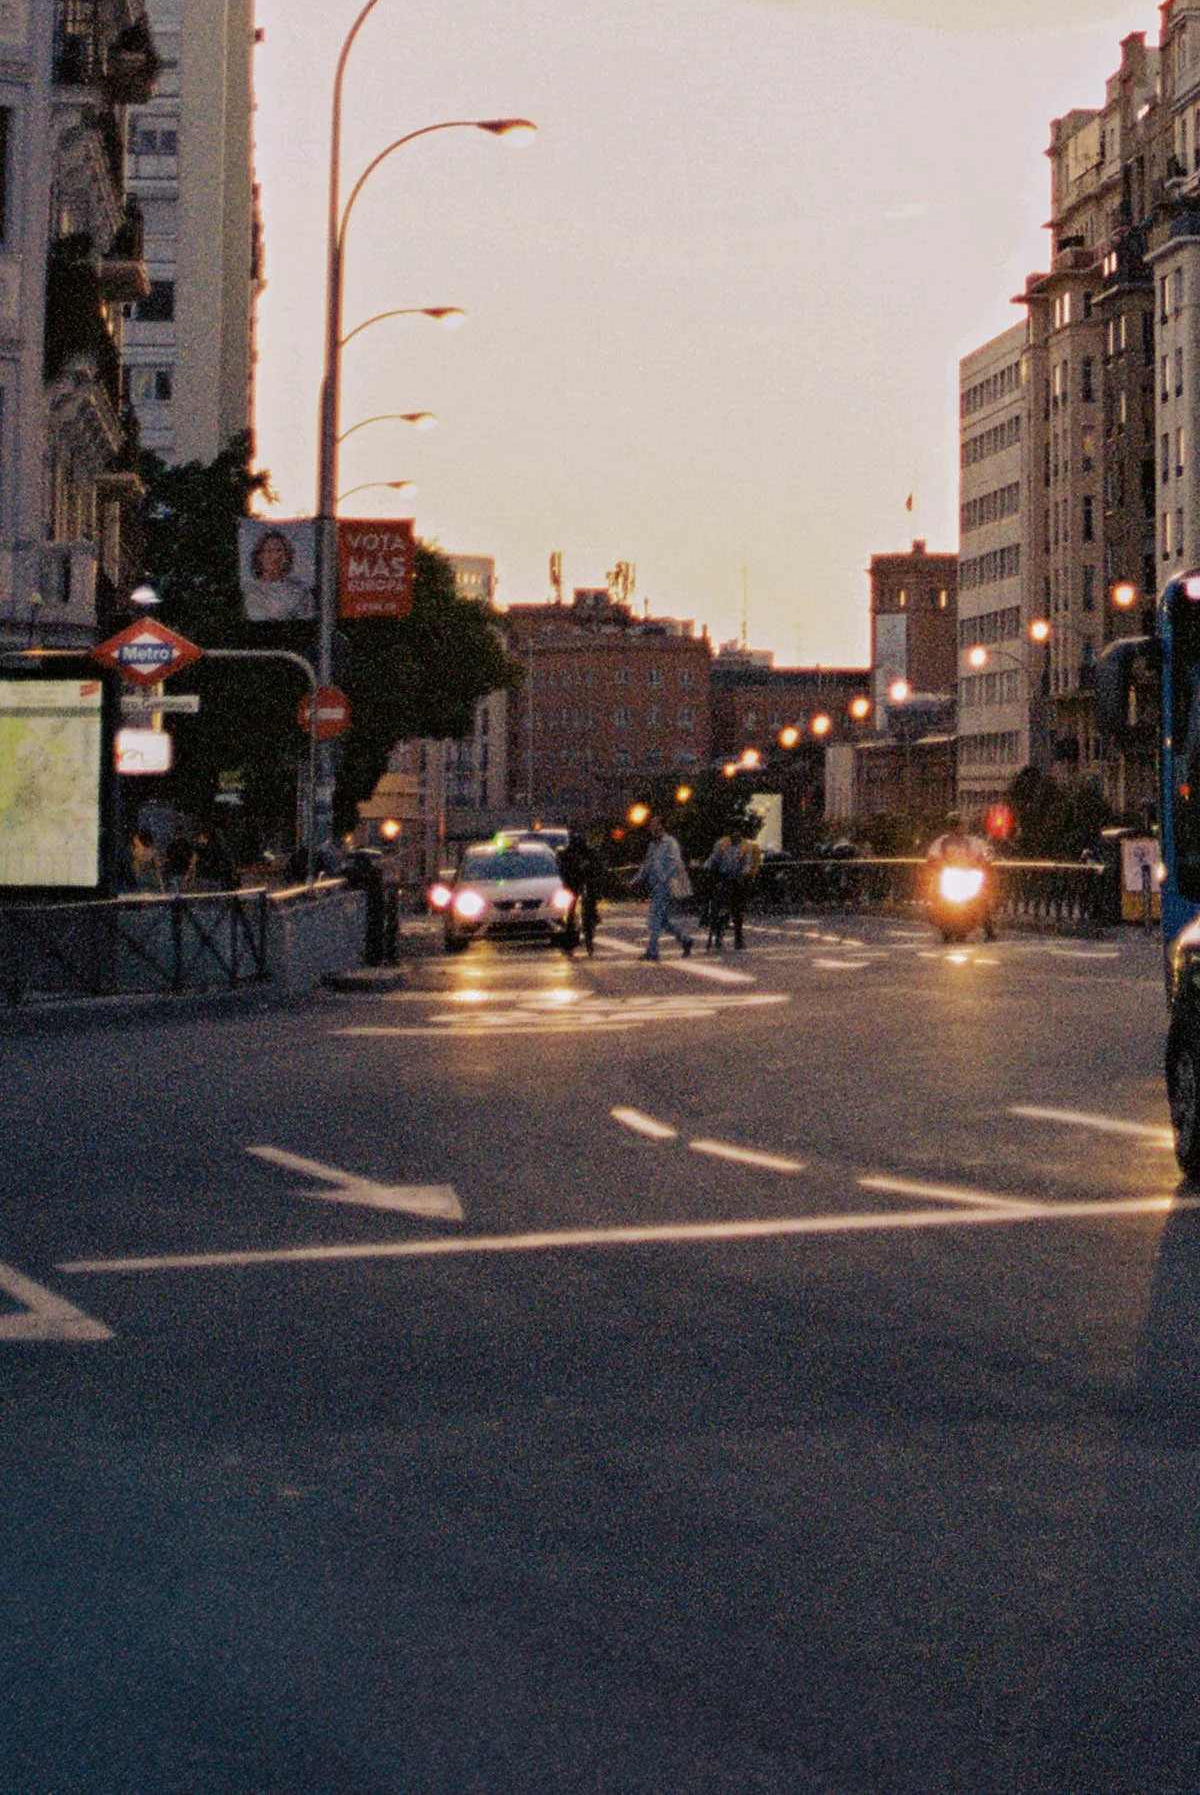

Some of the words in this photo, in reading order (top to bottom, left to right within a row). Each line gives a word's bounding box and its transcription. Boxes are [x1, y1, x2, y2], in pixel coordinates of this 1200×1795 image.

[346, 533, 406, 550] VOTA
[347, 552, 406, 577] MÁS
[122, 646, 169, 660] Metro
